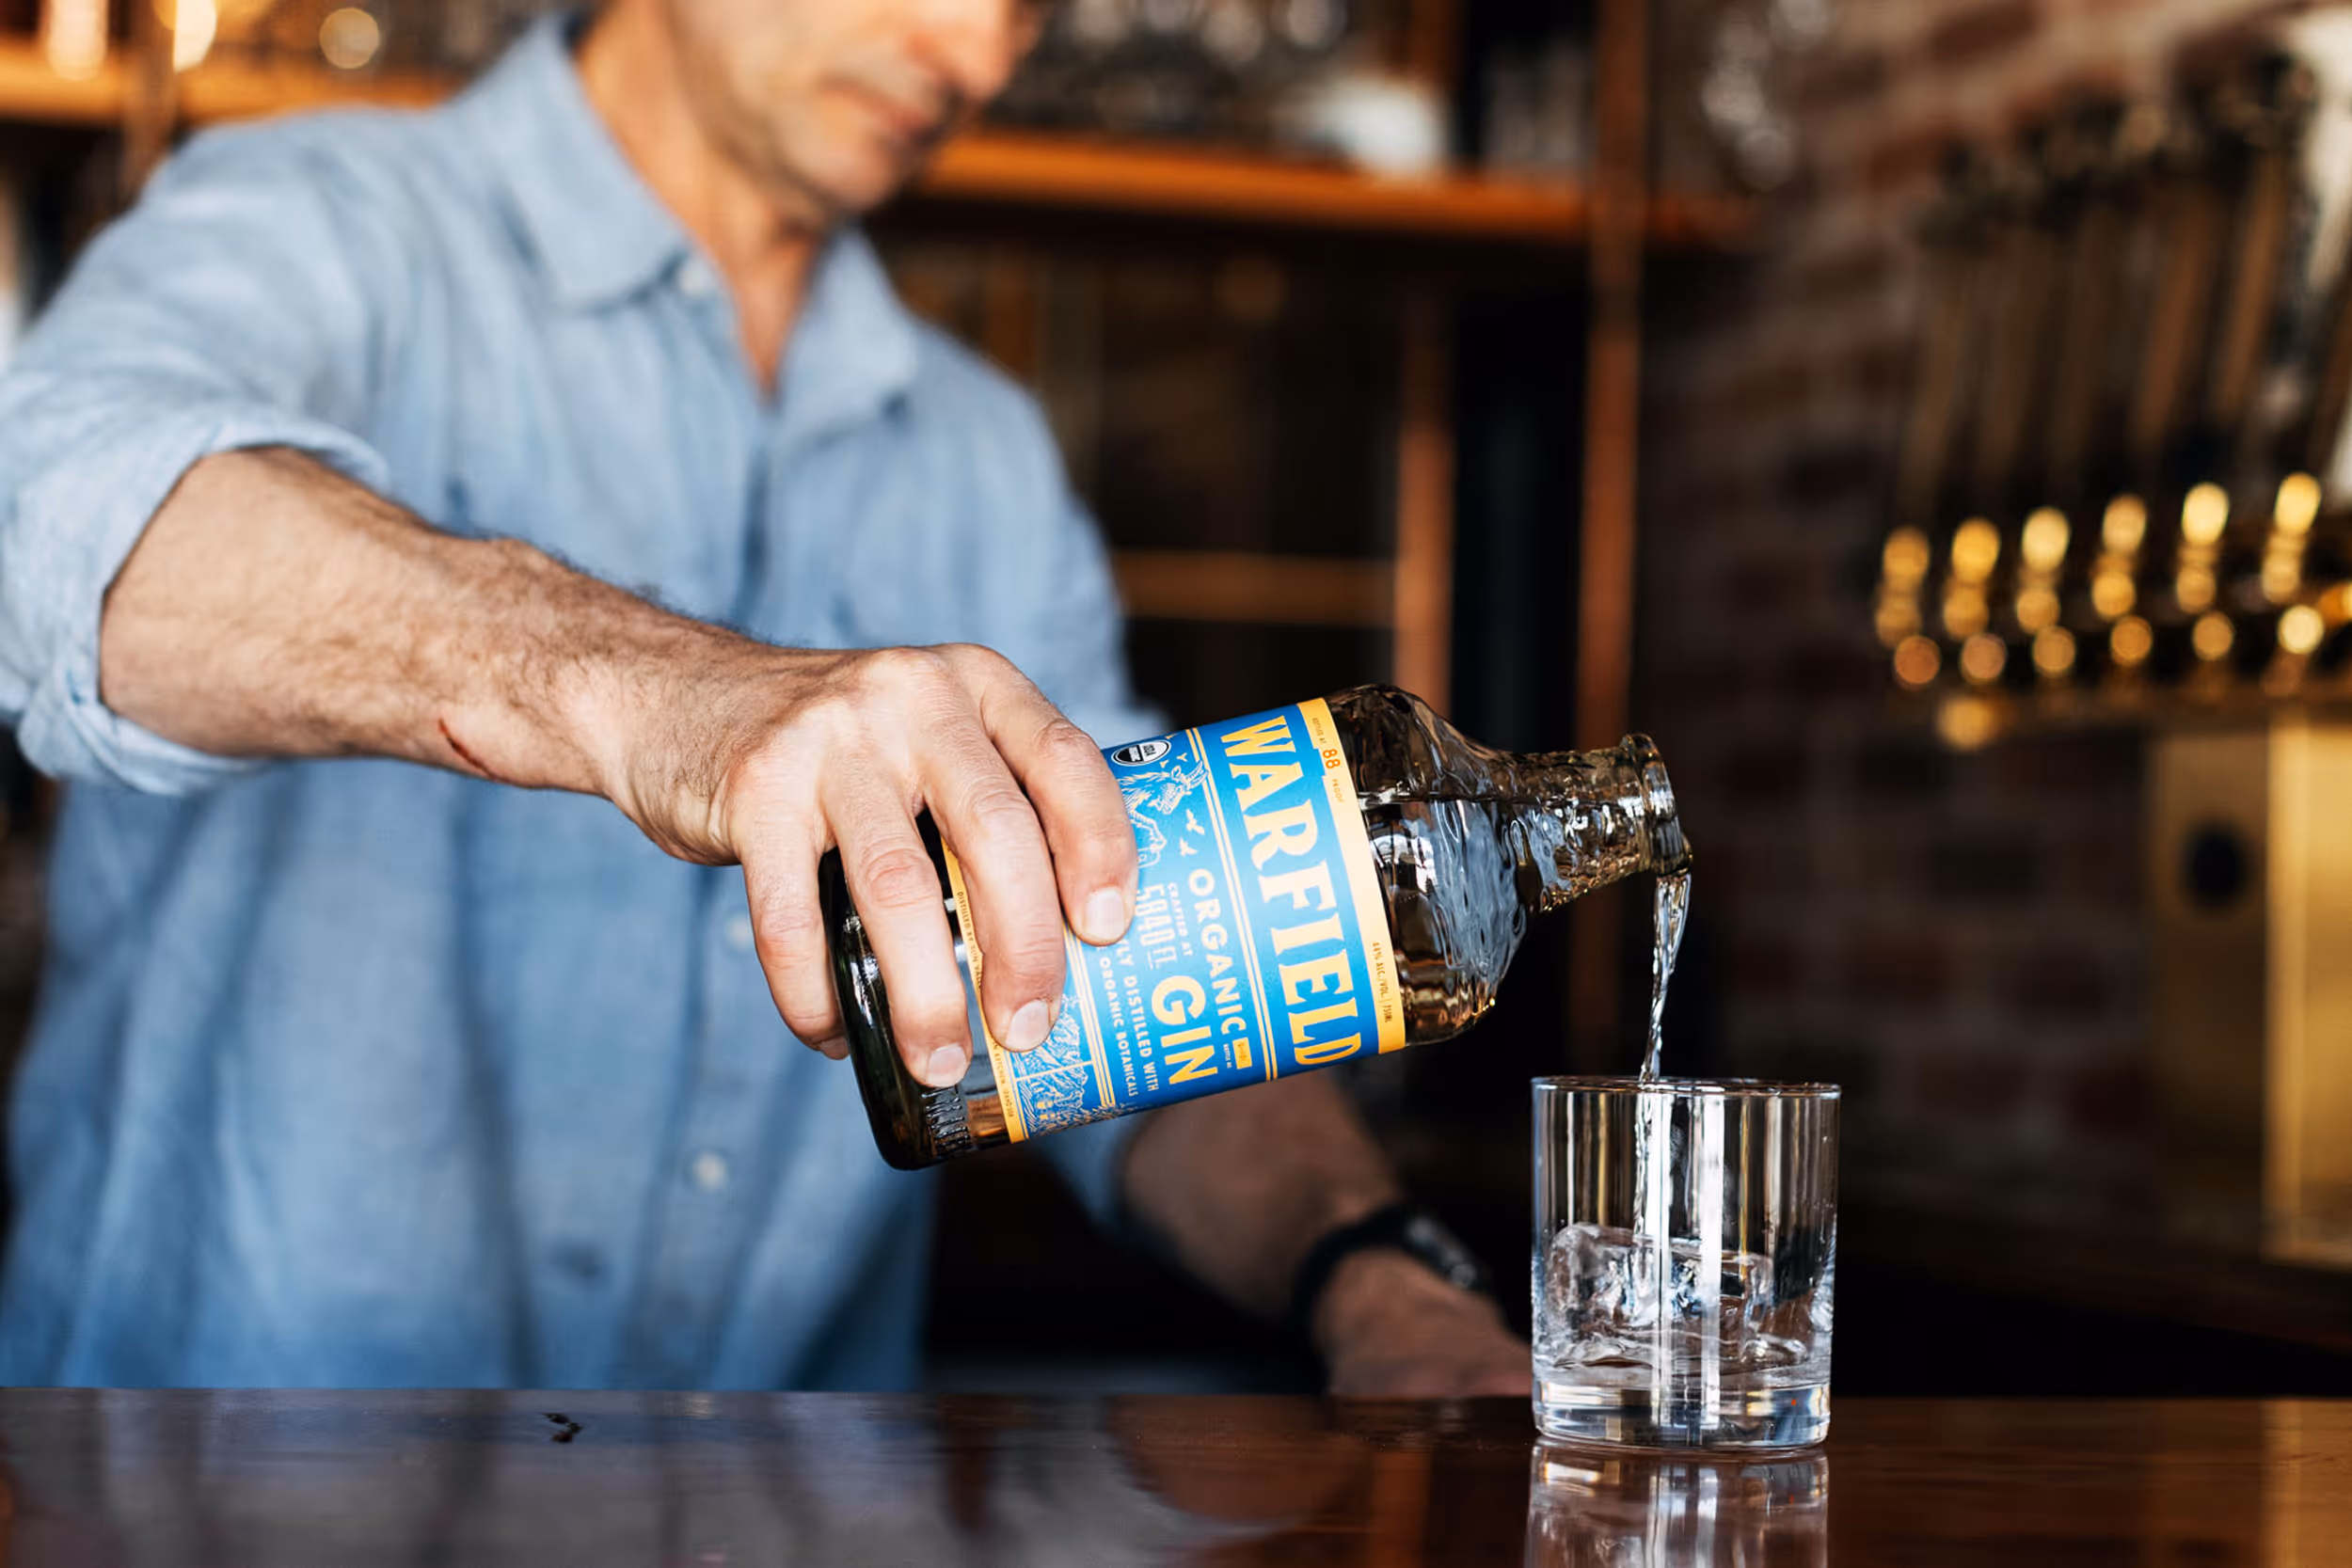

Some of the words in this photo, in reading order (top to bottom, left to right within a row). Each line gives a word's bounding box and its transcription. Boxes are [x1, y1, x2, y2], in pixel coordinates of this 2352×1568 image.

[1322, 748, 1341, 768] 88
[1331, 778, 1343, 802] PROOF
[1135, 884, 1175, 945] 5840
[1167, 882, 1188, 936] CRAFTED
[1181, 942, 1193, 956] AT
[1220, 715, 1361, 1064] WARFIELD
[1187, 868, 1246, 1034] ORGANIC
[1099, 956, 1123, 1026] ORGANIC
[1115, 1030, 1137, 1096] BOTANICALS
[1122, 974, 1152, 1056] DISTILLED
[1142, 1061, 1159, 1091] WITH
[1151, 974, 1217, 1084] GIN
